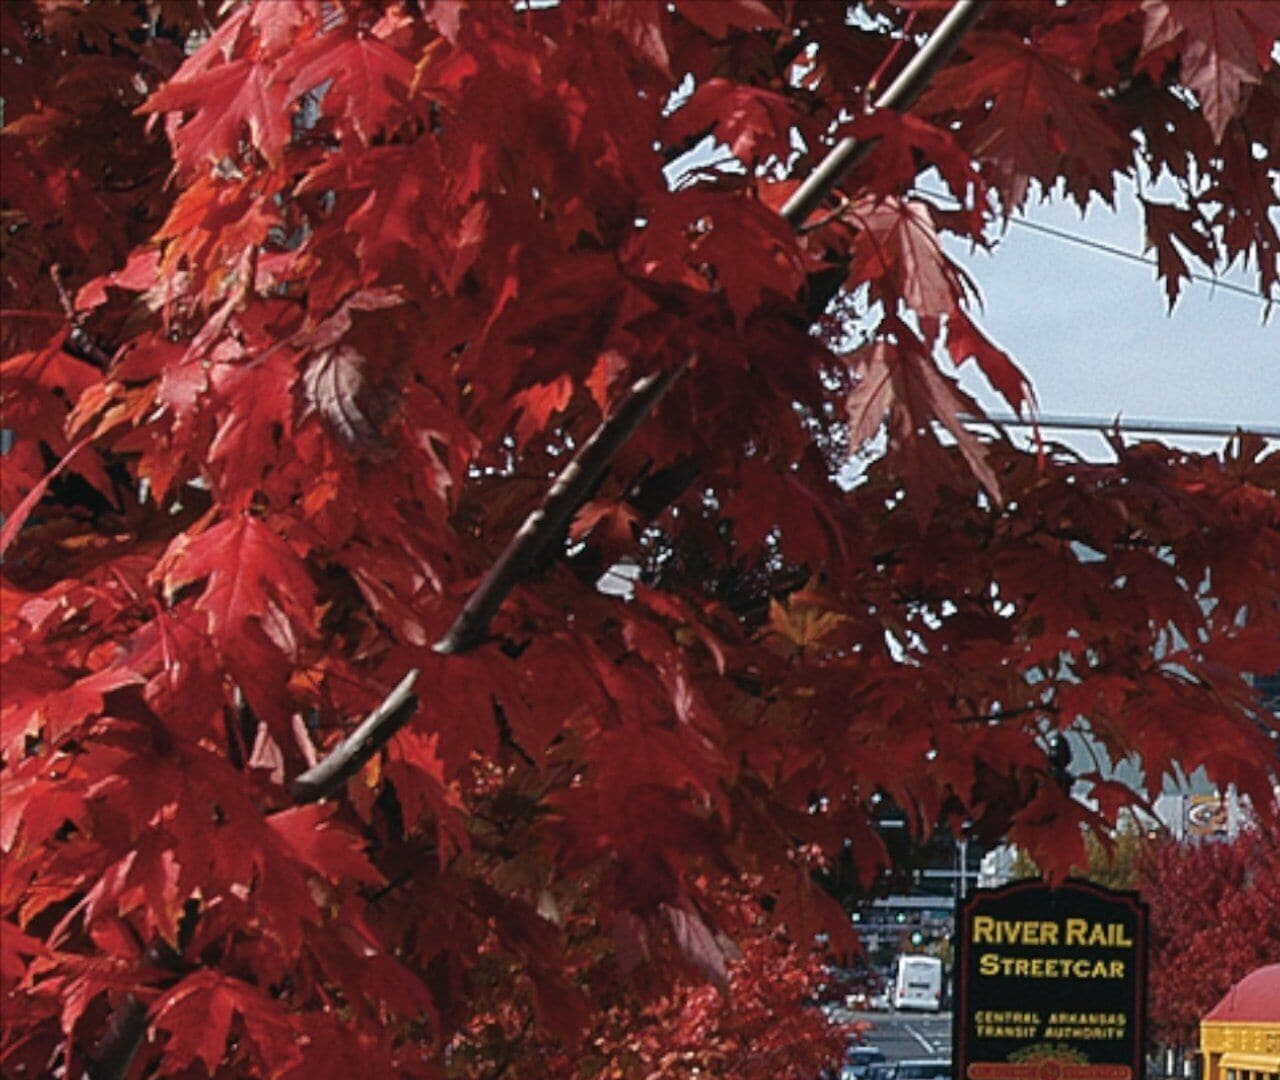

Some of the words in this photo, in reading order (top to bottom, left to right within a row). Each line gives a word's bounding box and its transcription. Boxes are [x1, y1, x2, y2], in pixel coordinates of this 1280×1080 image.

[972, 915, 1059, 946] RIVER
[1066, 917, 1132, 947] RAIL
[979, 953, 1125, 978] STREETCAR
[974, 1010, 1041, 1024] CENTRAL
[1049, 1012, 1127, 1026] ARKANSAS
[976, 1025, 1037, 1038] TRANSIT
[1044, 1026, 1126, 1040] AUTHORITY
